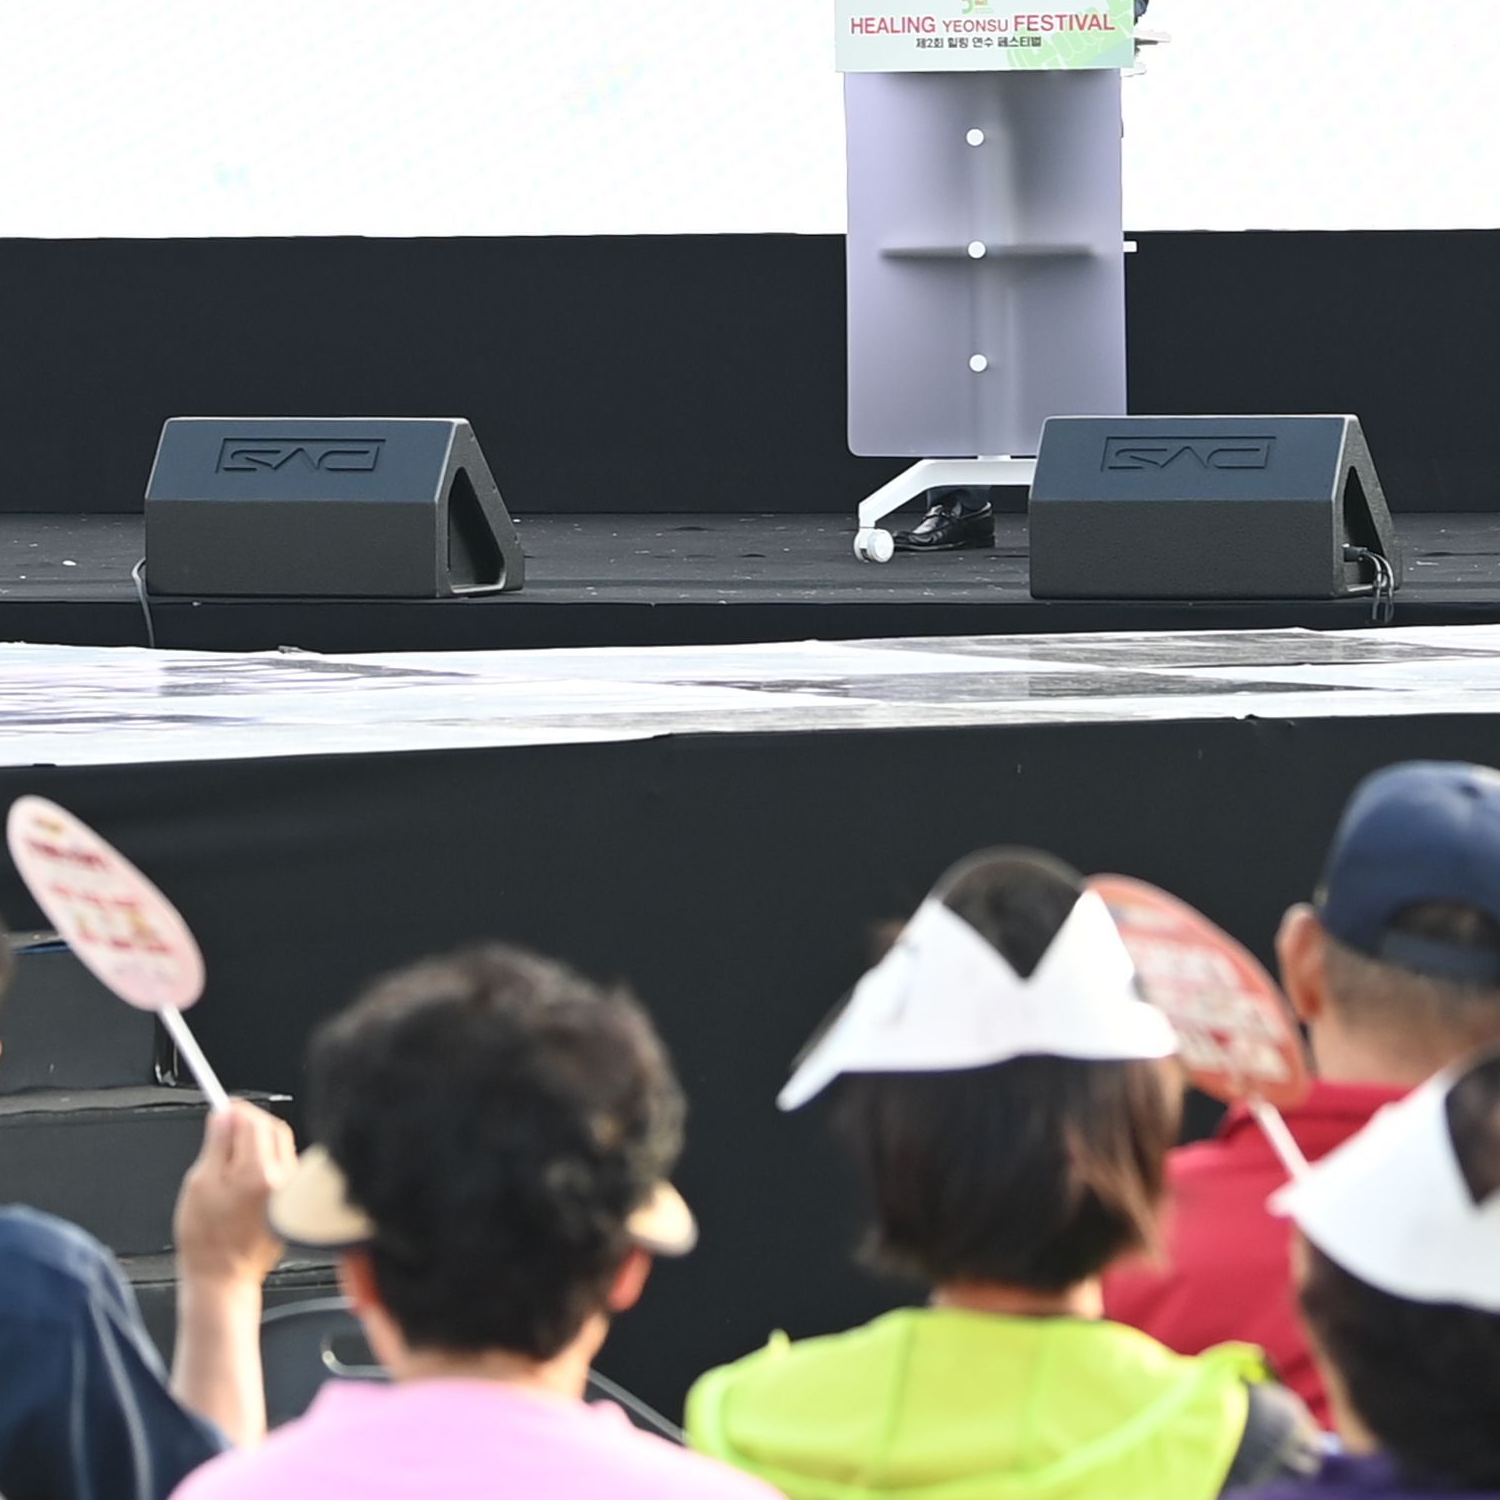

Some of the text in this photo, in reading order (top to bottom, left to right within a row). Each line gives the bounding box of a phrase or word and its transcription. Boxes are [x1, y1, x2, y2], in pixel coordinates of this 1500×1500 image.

[850, 14, 1116, 34] HEALING YEONSU FESTIVAL
[915, 36, 1042, 48] 제2회 힐링 연수 페스티벌
